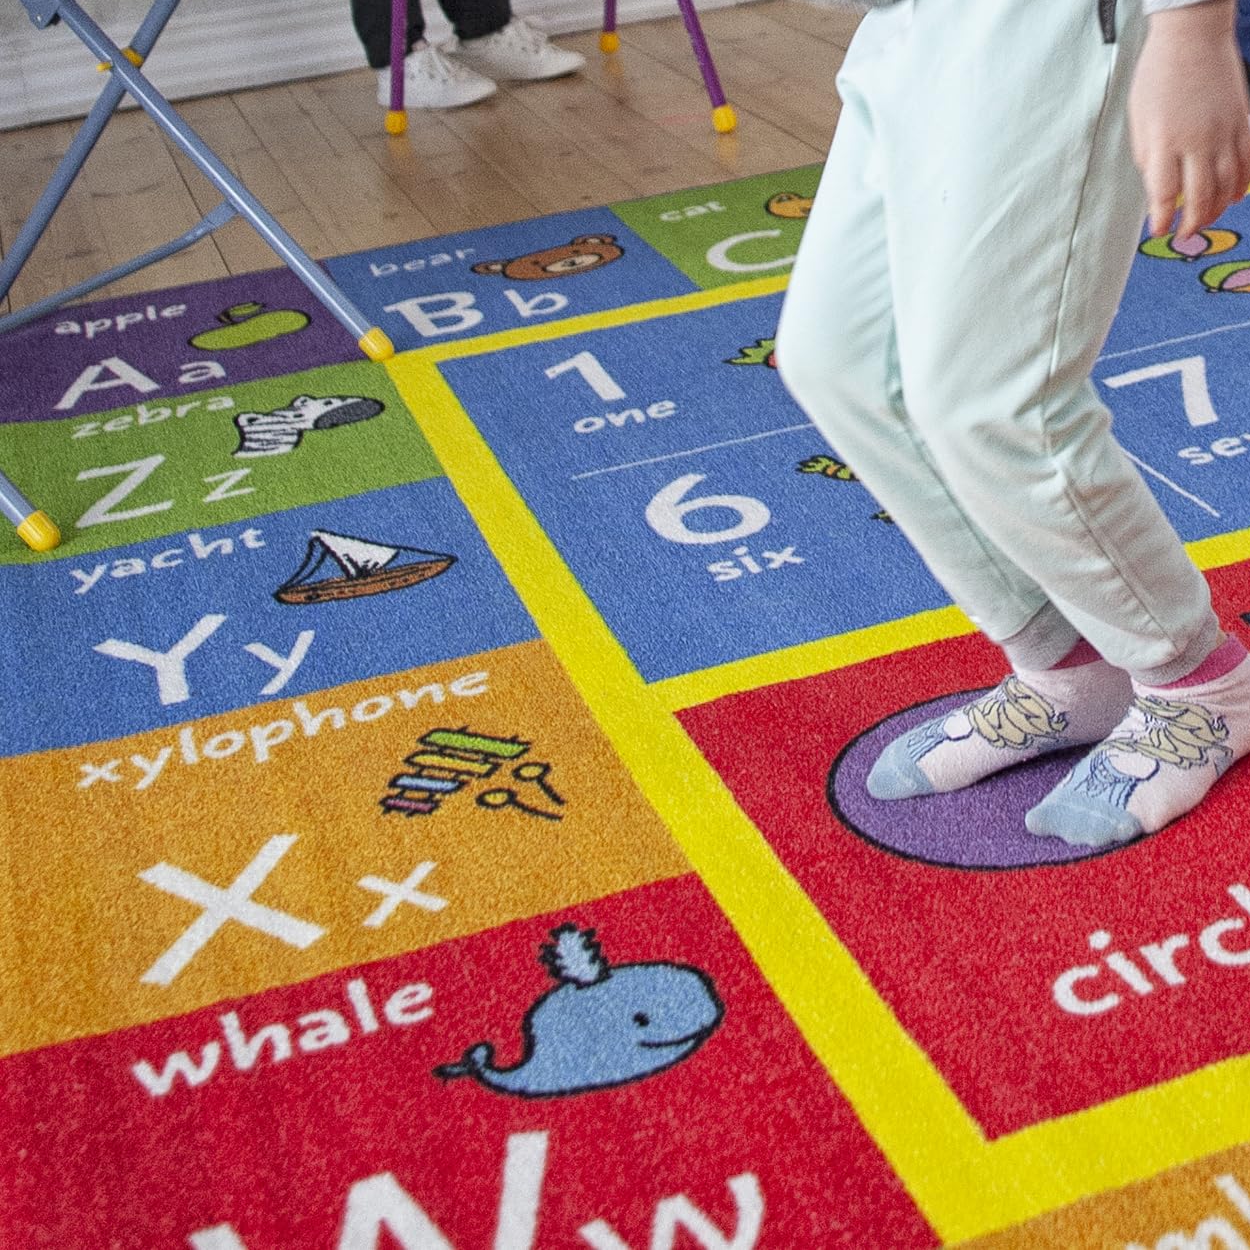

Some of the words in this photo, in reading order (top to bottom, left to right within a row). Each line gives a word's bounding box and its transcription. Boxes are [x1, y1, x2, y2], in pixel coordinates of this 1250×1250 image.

[659, 200, 726, 222] cat
[368, 247, 479, 279] bear
[705, 229, 797, 273] C
[53, 299, 188, 341] apple
[545, 351, 627, 402] 1
[1102, 355, 1218, 428] 7
[70, 392, 236, 441] zebra
[573, 397, 678, 436] one
[644, 473, 772, 546] 6
[70, 525, 268, 594] yacht
[707, 546, 805, 582] six
[75, 669, 491, 791] xylophone
[131, 978, 435, 1098] whale
